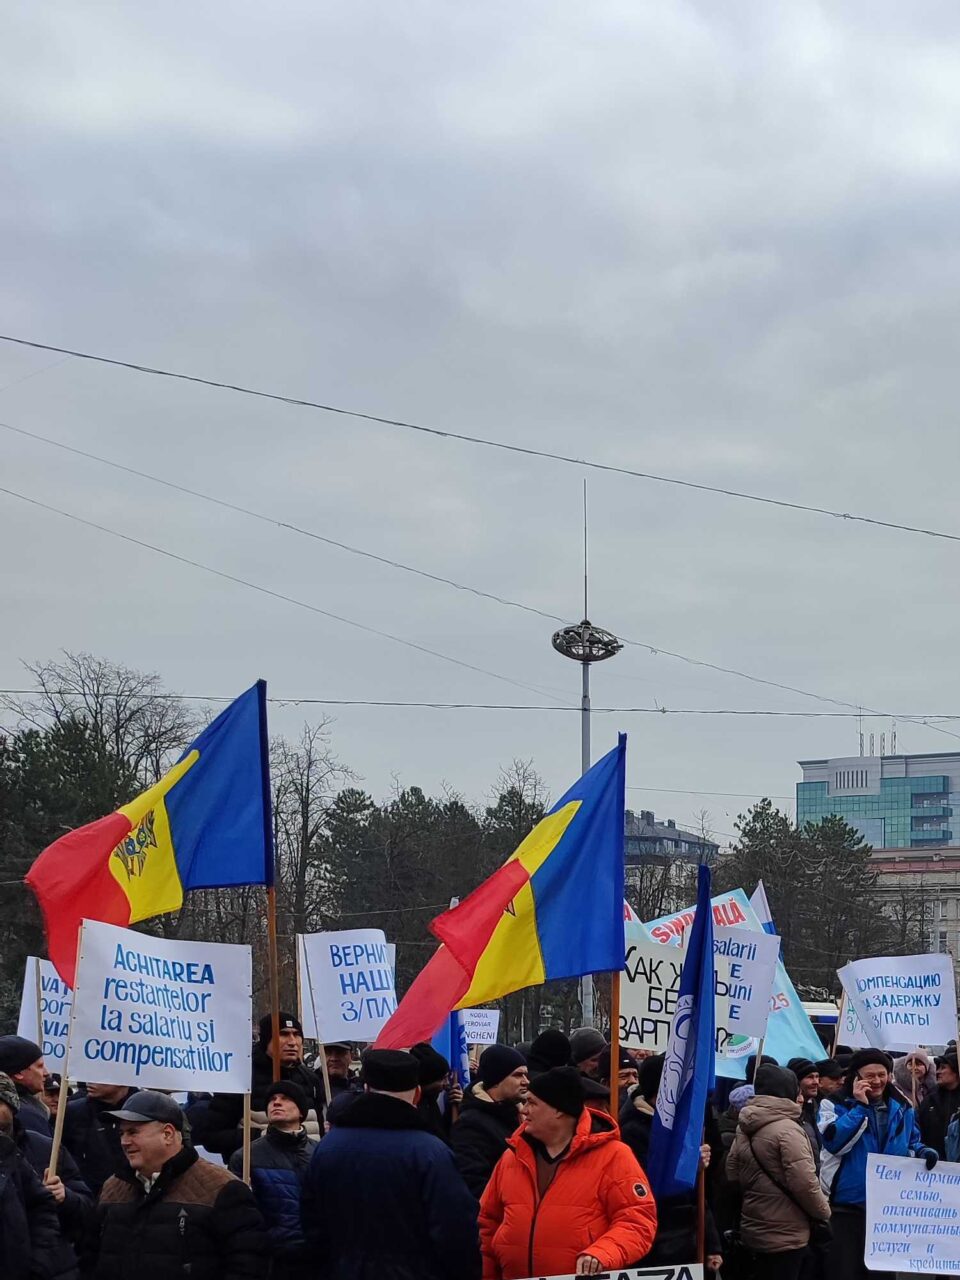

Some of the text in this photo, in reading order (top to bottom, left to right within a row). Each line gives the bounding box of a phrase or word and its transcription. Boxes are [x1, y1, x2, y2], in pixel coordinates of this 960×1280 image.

[114, 944, 215, 984] ACHITAREA
[104, 977, 211, 1013] restanțelor
[101, 1005, 122, 1030] la
[129, 1011, 192, 1041] salariu
[872, 1011, 930, 1029] З/ПЛАТЫ
[465, 1031, 495, 1039] NGHENI
[84, 1038, 233, 1076] compensațiilor
[875, 1164, 902, 1181] Чем
[900, 1189, 942, 1203] семью,
[882, 1205, 958, 1219] оплачивать
[870, 1240, 935, 1256] услуги и
